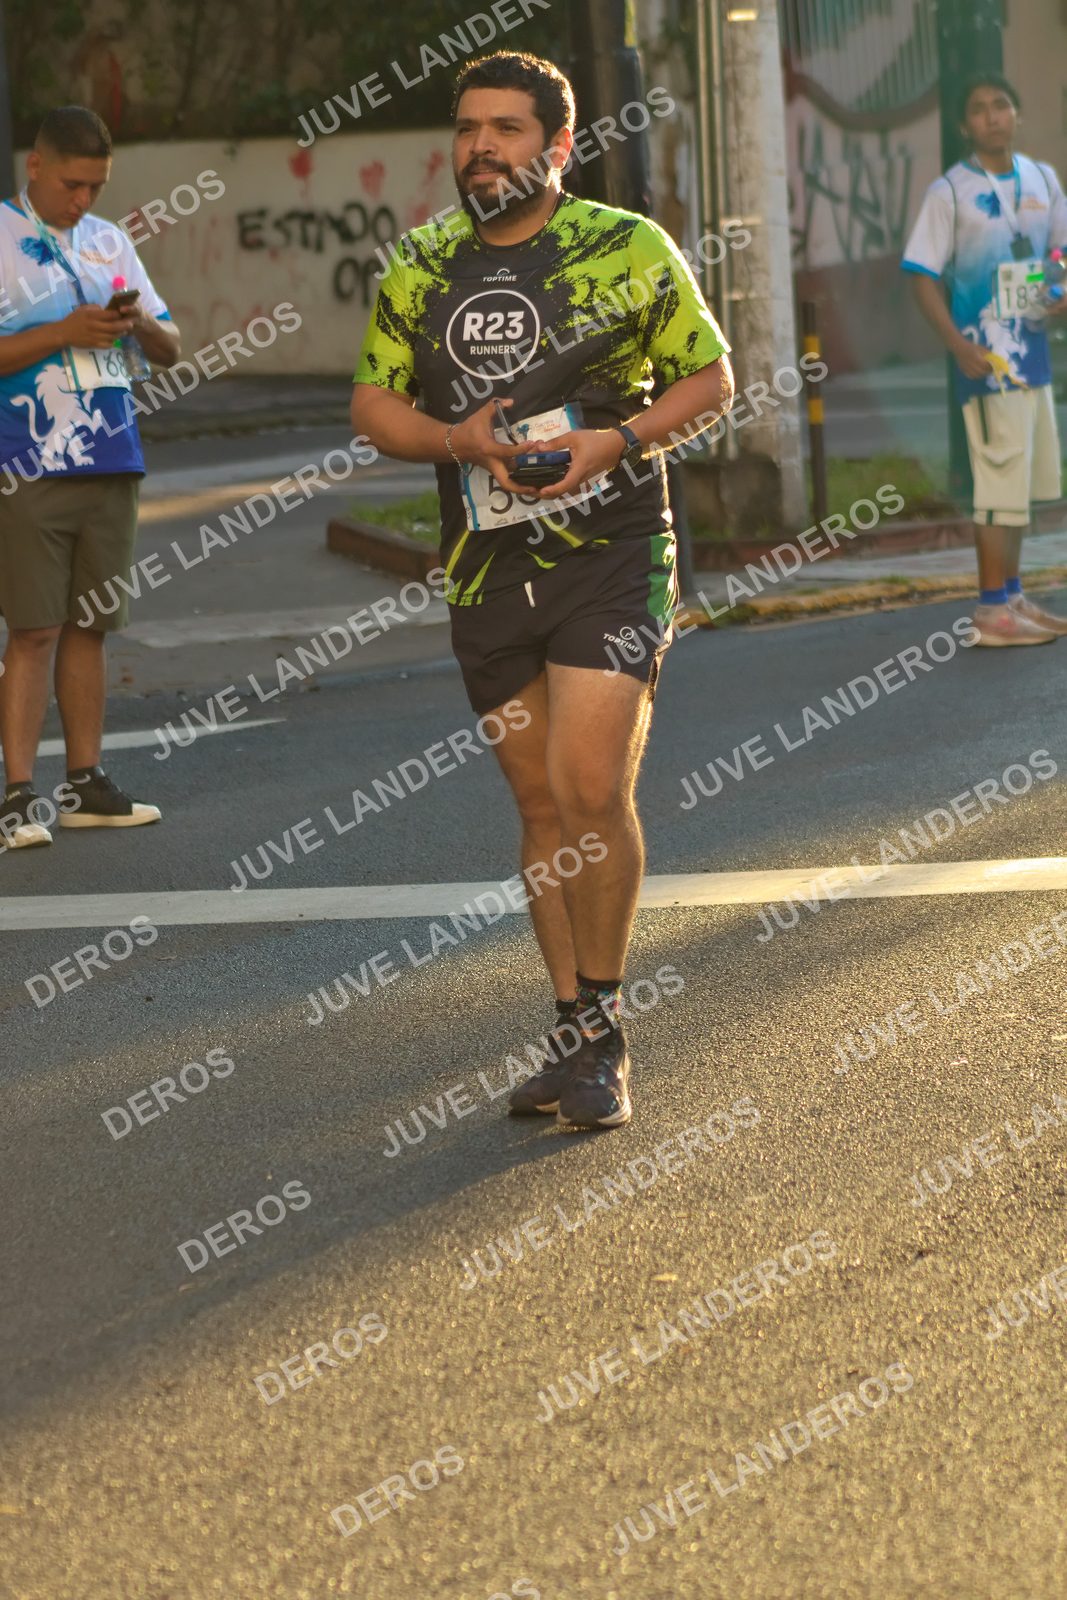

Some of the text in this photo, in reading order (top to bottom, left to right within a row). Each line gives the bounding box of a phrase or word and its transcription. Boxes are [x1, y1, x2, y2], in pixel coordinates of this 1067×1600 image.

[463, 311, 524, 341] R23
[470, 345, 516, 355] RUNNERS
[603, 633, 640, 653] TOPTIME
